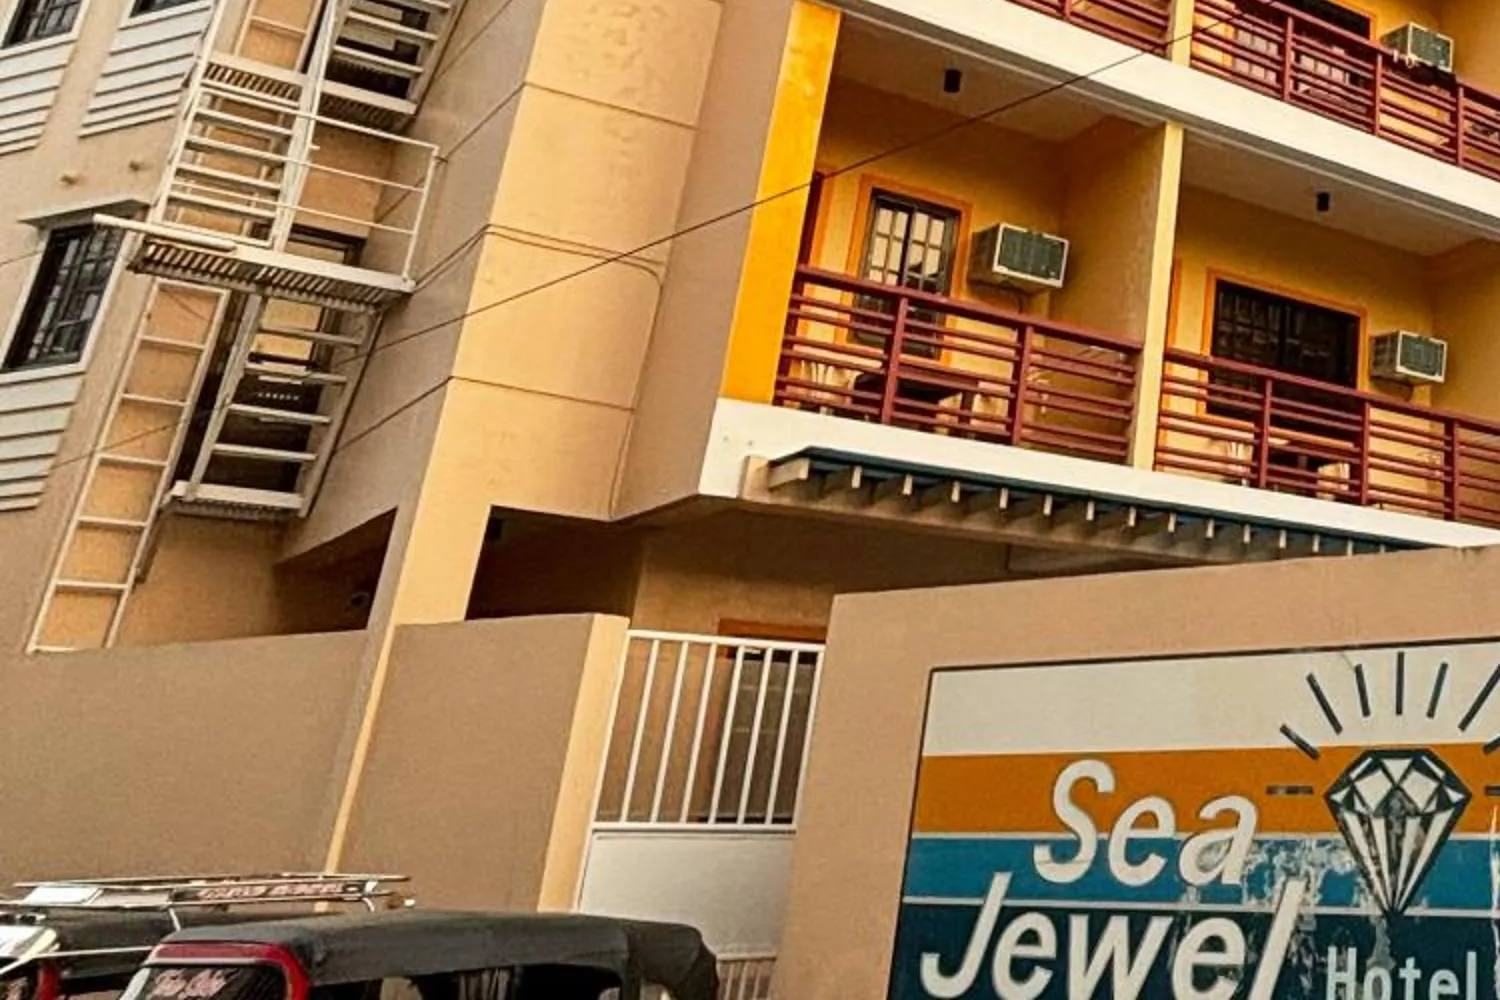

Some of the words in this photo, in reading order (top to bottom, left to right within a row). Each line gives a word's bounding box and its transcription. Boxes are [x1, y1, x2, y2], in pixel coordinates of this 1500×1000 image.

[1033, 759, 1258, 887] Sea
[920, 872, 1305, 1000] Jewel
[1326, 946, 1477, 1000] Hotel
